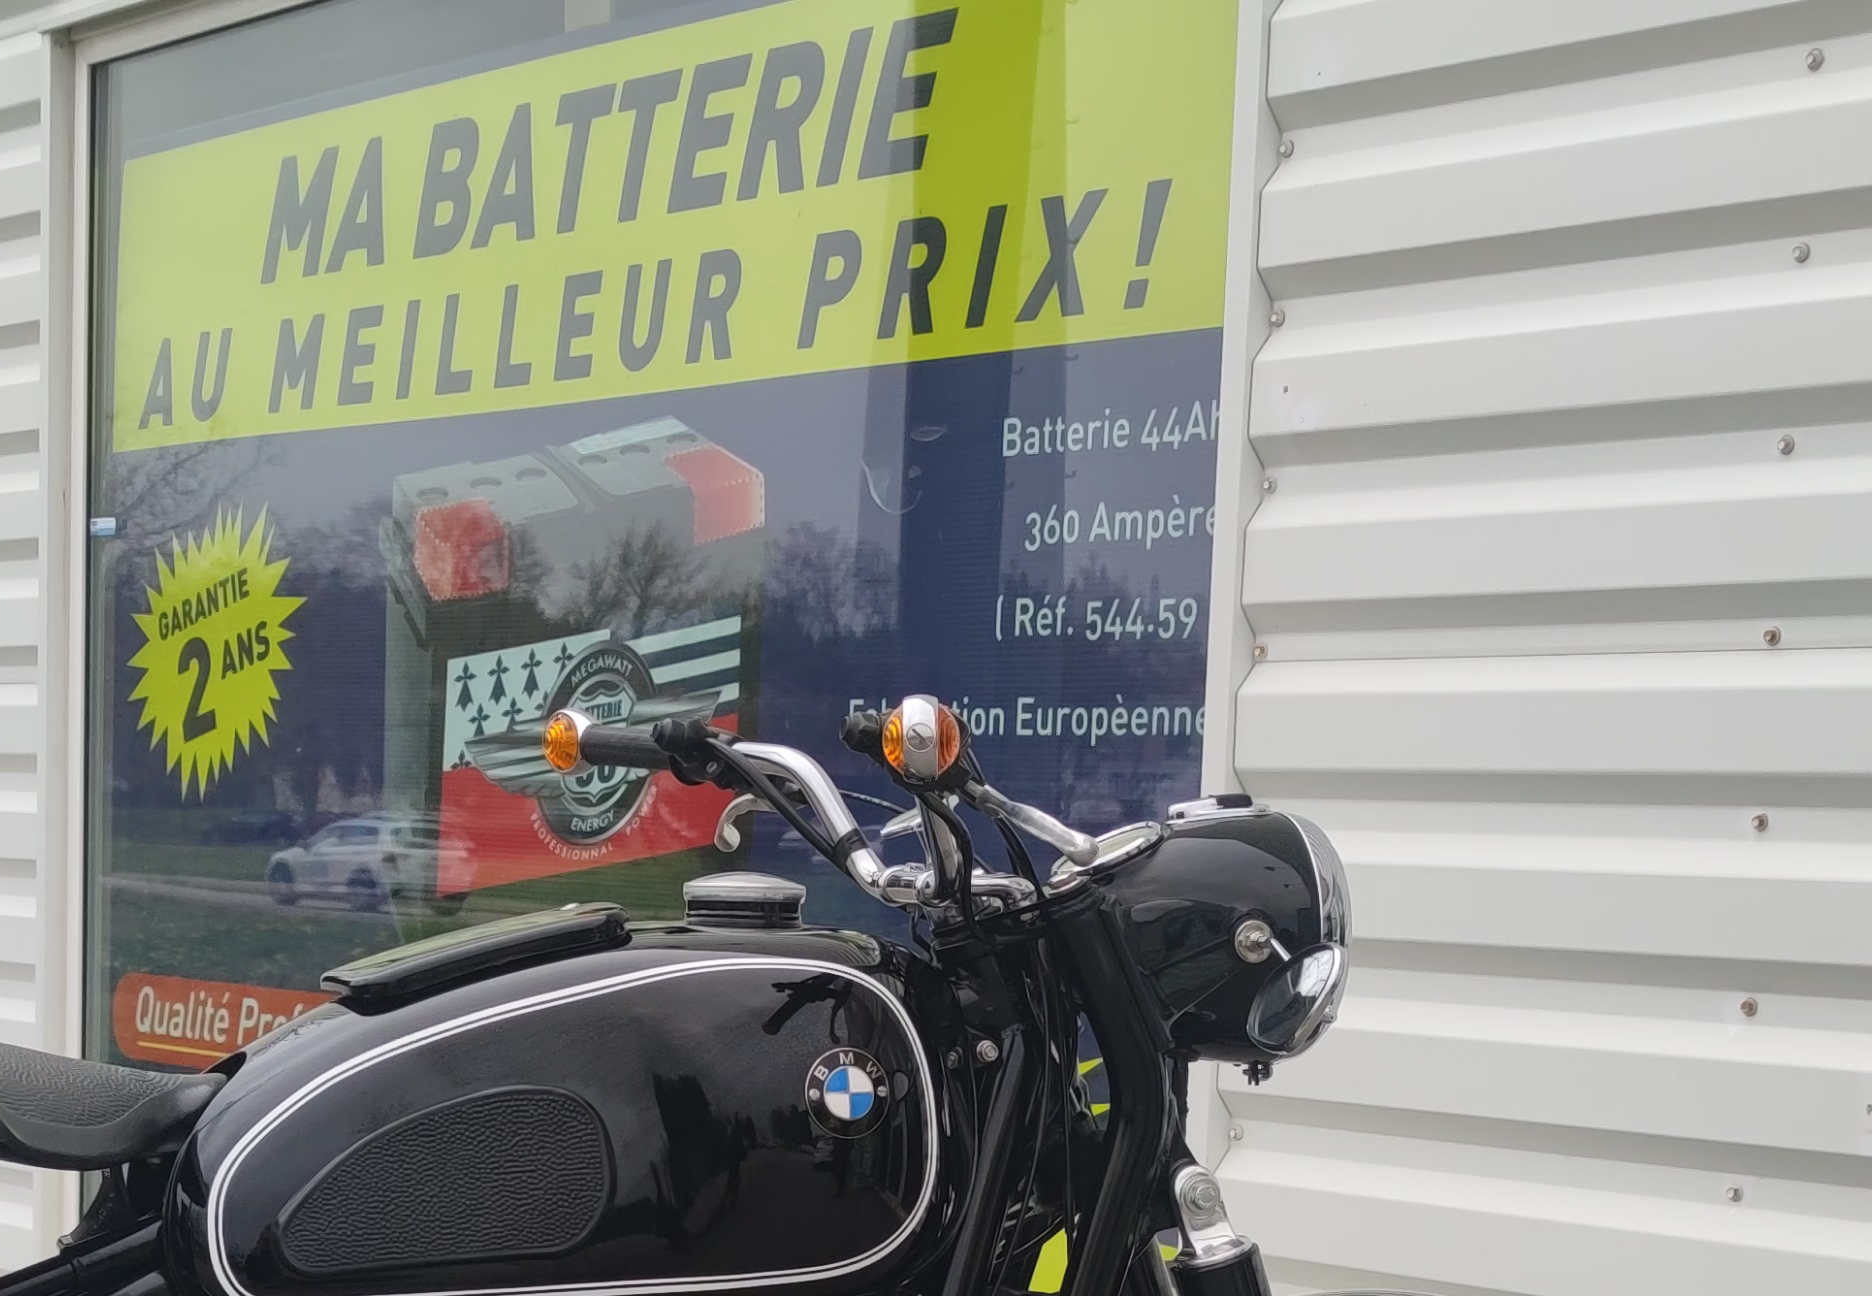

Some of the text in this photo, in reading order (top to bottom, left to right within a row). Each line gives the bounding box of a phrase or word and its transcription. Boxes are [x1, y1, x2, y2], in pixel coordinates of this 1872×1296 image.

[259, 7, 959, 285] MA BATTERIE
[138, 326, 232, 431] AU
[266, 246, 743, 414] MEILLEUR
[1001, 409, 1131, 458] Batterie
[1024, 504, 1080, 552] 360
[158, 567, 251, 642] GARANTIE
[1085, 597, 1198, 641] 544.59
[177, 620, 271, 745] 2 ANS
[569, 653, 633, 688] MEGAWATT
[529, 811, 614, 861] PROFESSIONNAL
[570, 808, 615, 832] ENERGY
[135, 985, 231, 1045] Qualité
